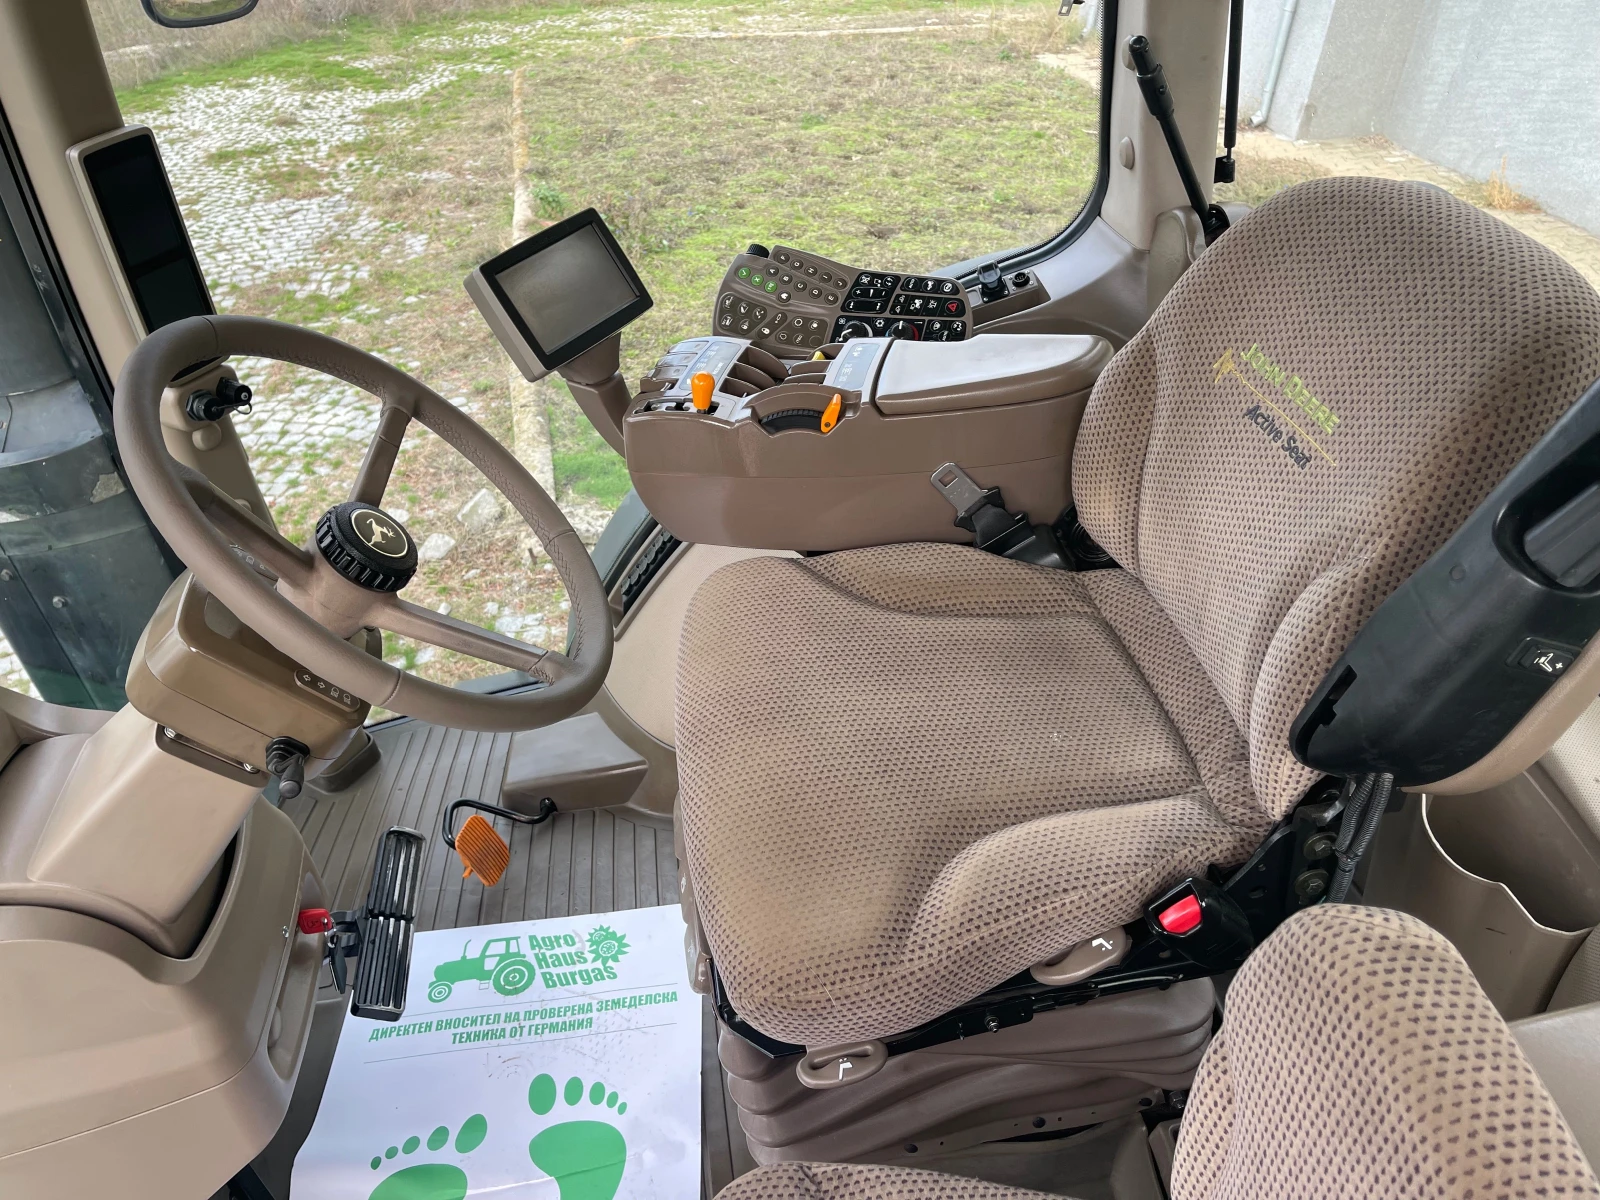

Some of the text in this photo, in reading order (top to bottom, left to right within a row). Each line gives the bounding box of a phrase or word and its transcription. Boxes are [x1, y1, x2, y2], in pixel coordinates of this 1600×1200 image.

[1240, 343, 1341, 435] JOHN DEERE
[1242, 404, 1312, 470] Active Seat
[528, 934, 577, 951] Agro
[533, 951, 588, 970] Haus
[540, 965, 618, 989] Burgas
[368, 991, 678, 1042] ДИРЕКТЕН ВНОСИТЕЛ НА ПРОВЕРЕНА ЗЕМЕДЕЛСКА
[451, 1016, 594, 1045] ТЕХНИКА ОТ ГЕРМАНИЯ
